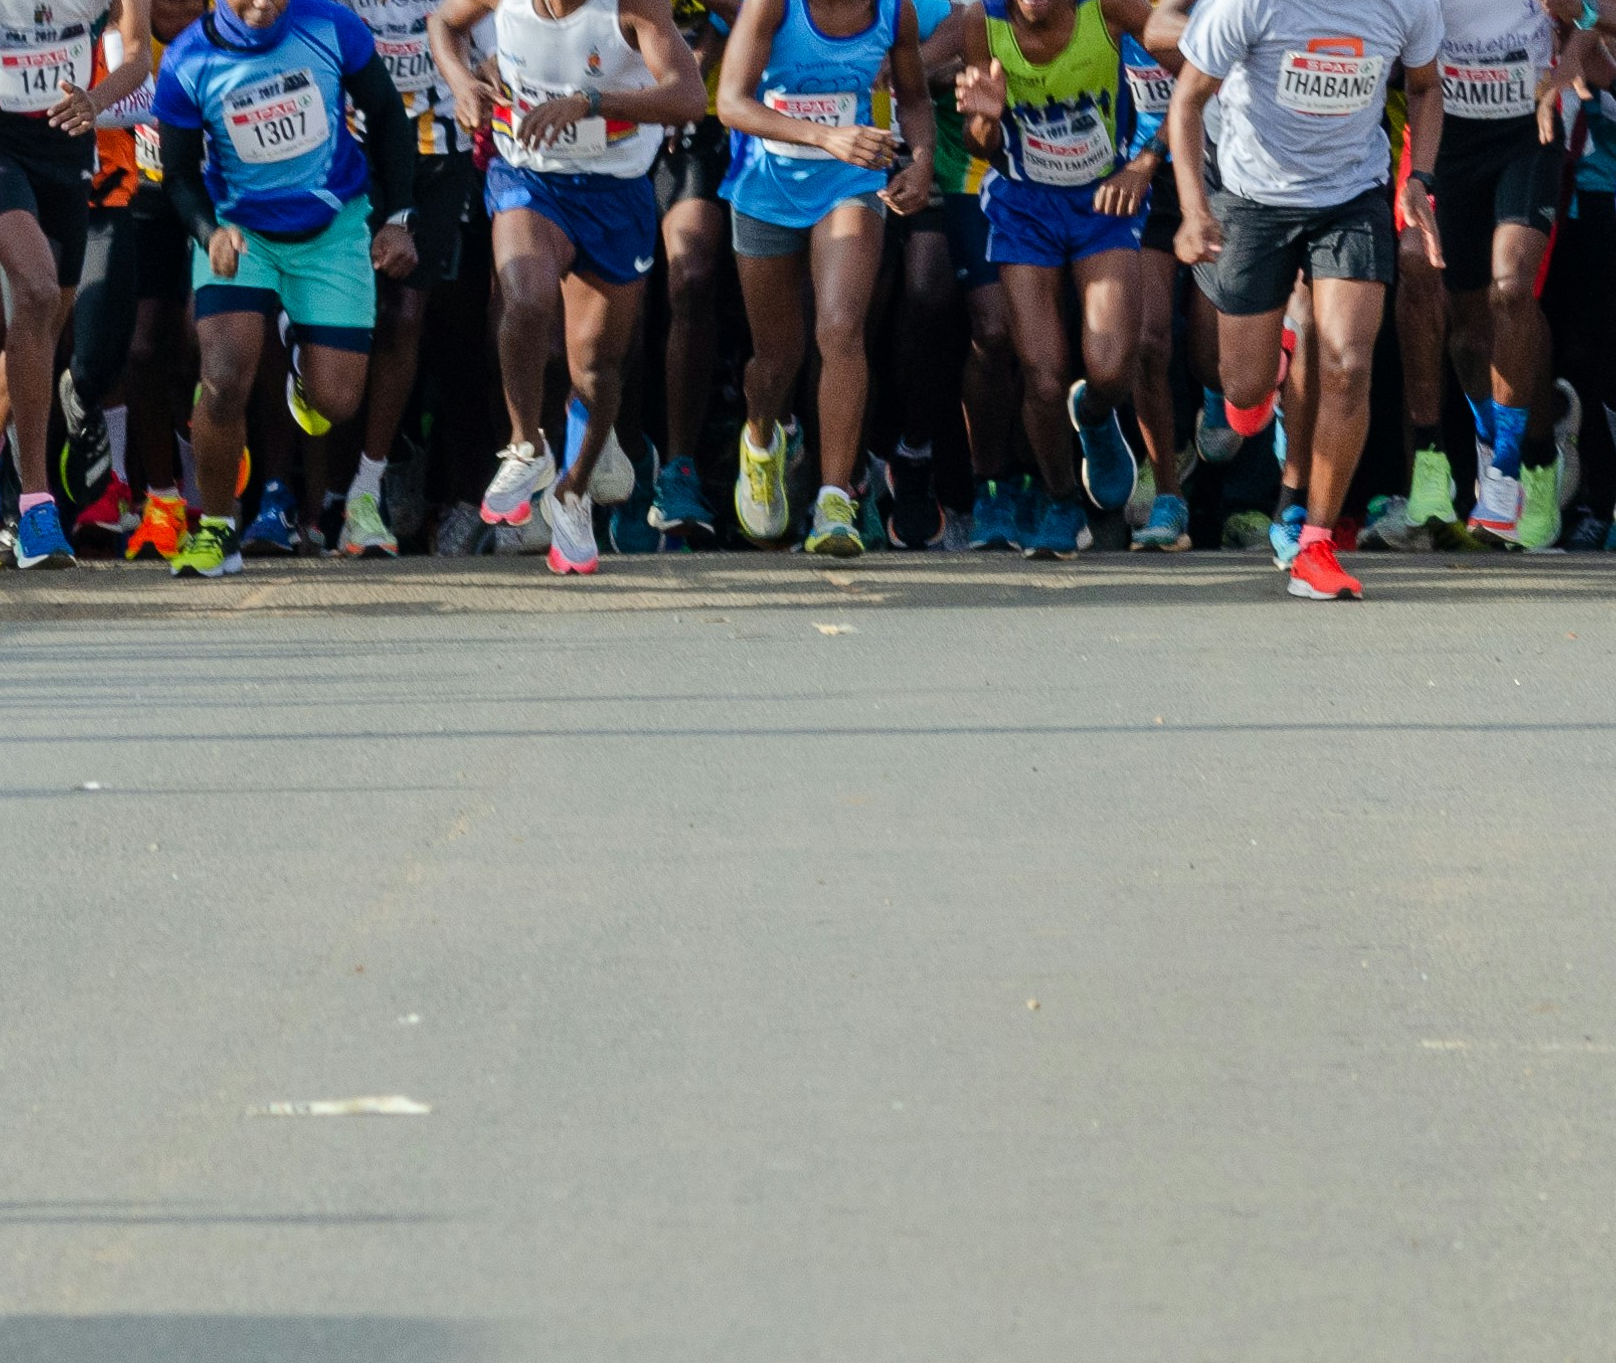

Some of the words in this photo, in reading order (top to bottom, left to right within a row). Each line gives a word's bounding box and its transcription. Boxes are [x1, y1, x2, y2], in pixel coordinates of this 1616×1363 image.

[1306, 59, 1358, 74] SPAR
[1132, 79, 1175, 101] 118
[1285, 69, 1376, 98] THABANG
[1442, 77, 1531, 105] SAMUEL
[786, 99, 837, 113] SPAR
[254, 112, 306, 148] 1307
